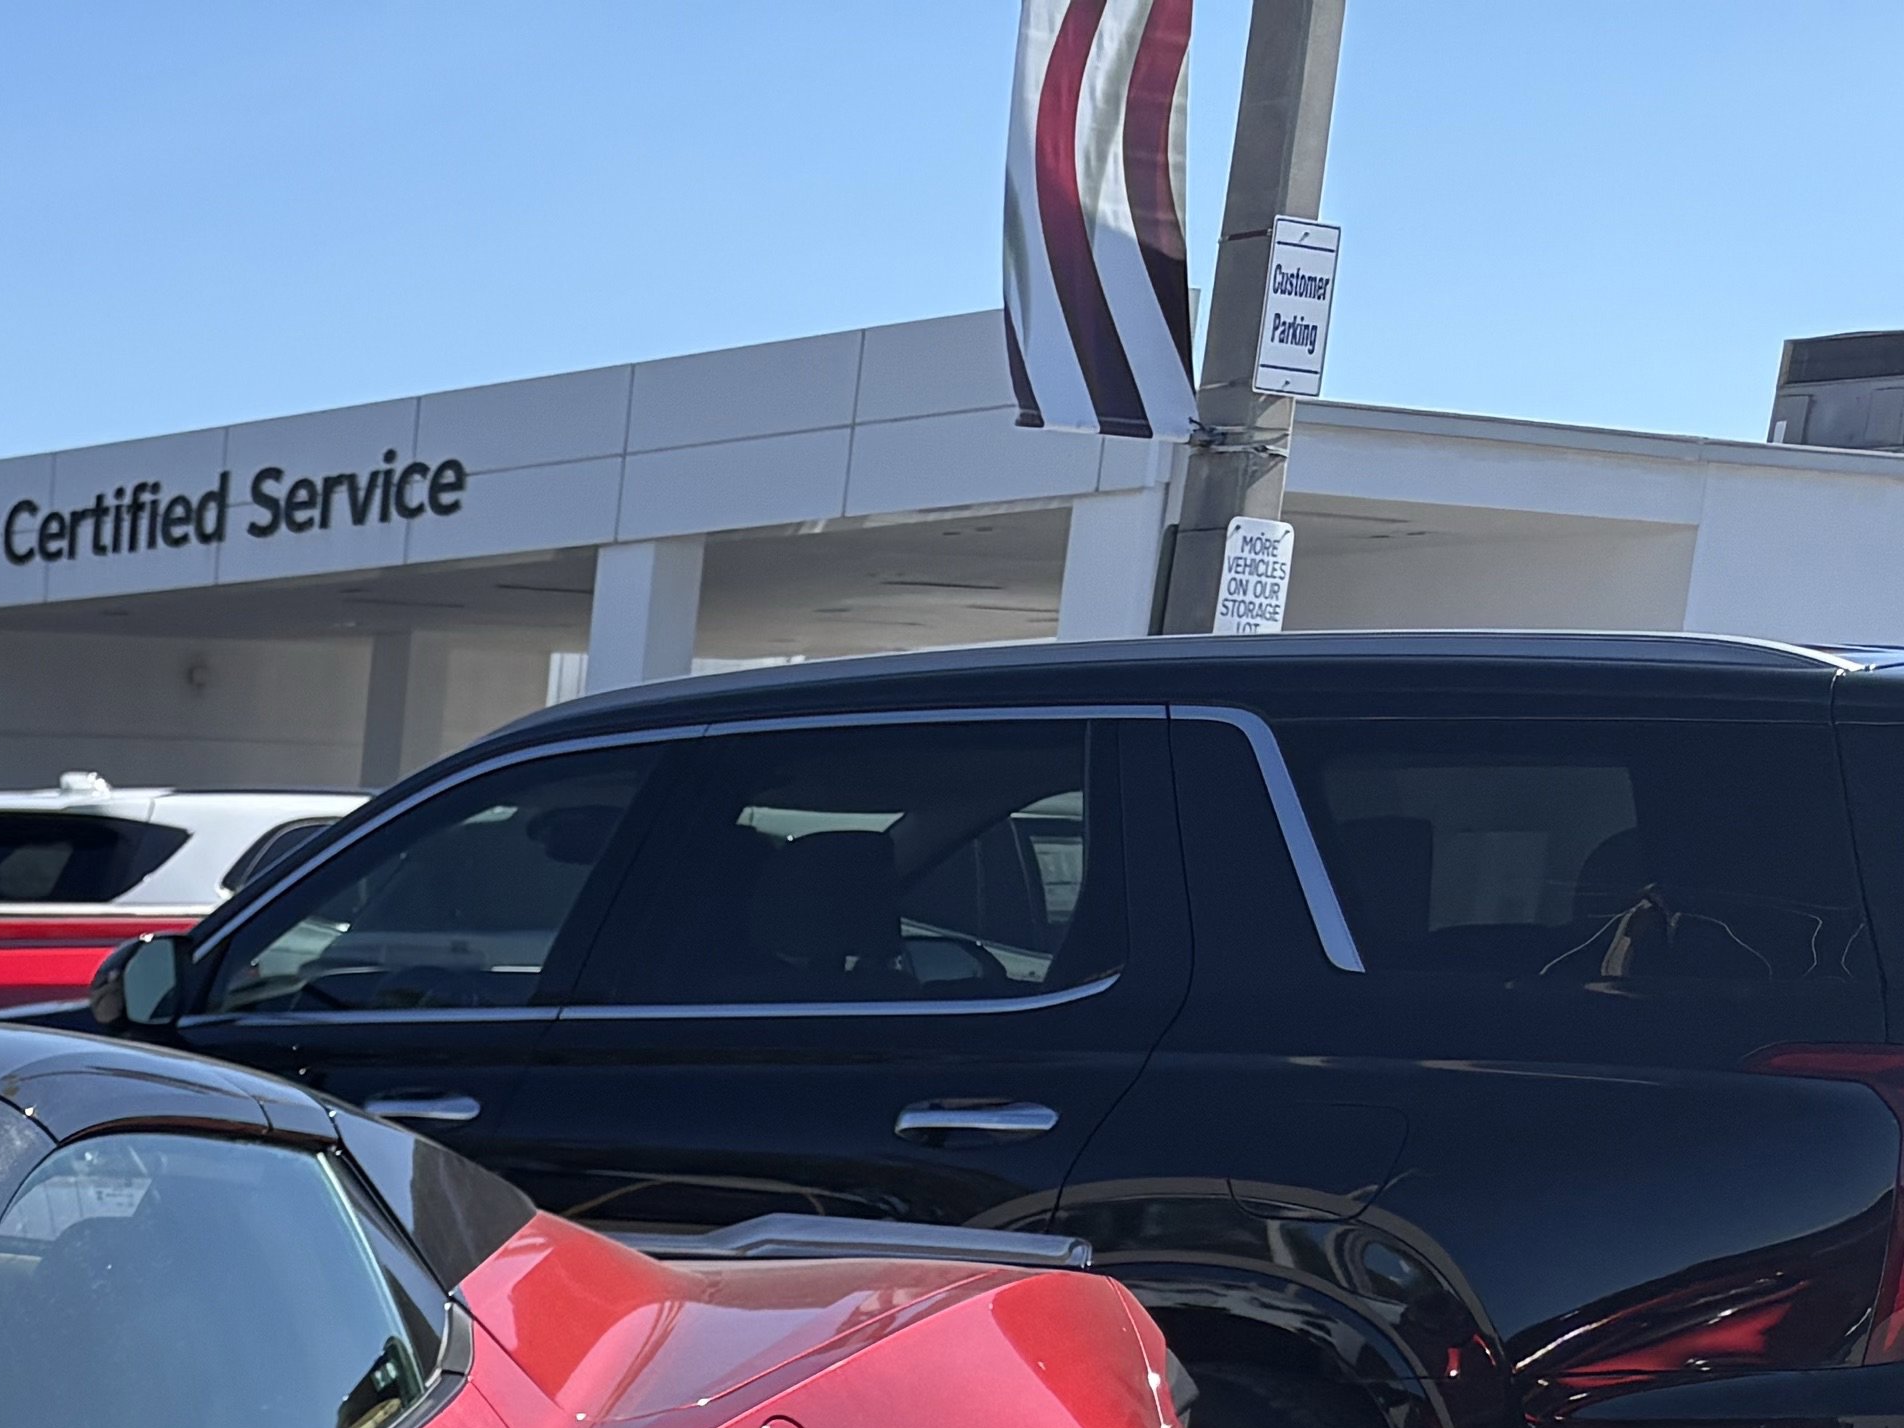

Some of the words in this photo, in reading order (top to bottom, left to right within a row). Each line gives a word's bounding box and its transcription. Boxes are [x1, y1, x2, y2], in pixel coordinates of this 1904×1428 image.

[1272, 263, 1331, 301] Customer
[1270, 312, 1319, 355] Parking
[4, 469, 231, 567] Certified
[246, 448, 459, 538] Service
[1241, 534, 1282, 558] MORE
[1227, 555, 1288, 581] VEHICLES
[1226, 577, 1250, 597] ON
[1253, 580, 1282, 601] OUR
[1220, 598, 1282, 622] STORAGE
